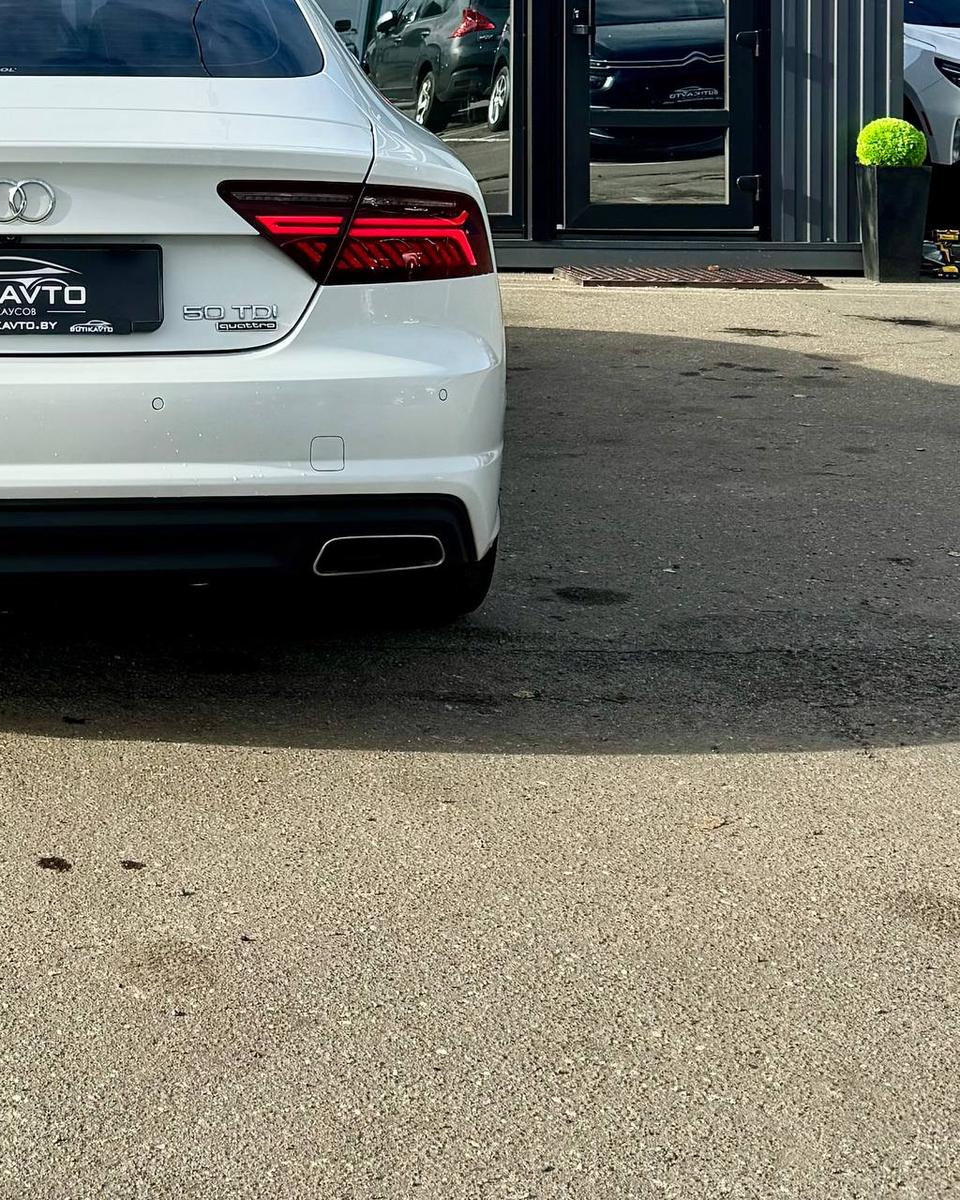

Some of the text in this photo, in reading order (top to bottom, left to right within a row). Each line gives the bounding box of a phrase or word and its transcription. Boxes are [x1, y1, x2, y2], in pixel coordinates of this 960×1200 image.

[183, 304, 278, 320] 50 TDI
[218, 321, 276, 331] quattro
